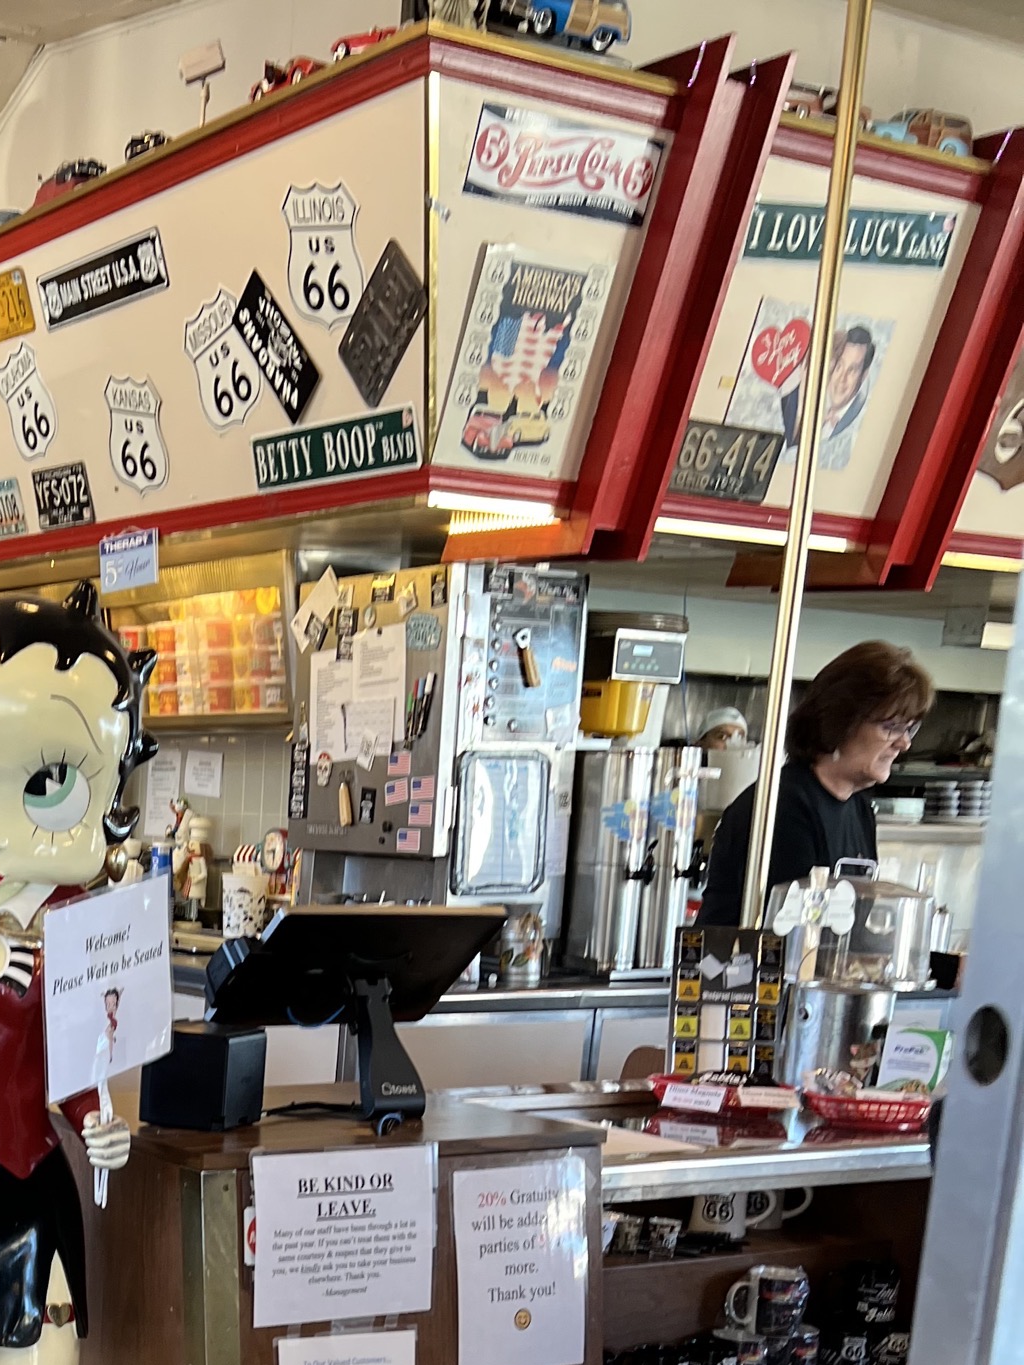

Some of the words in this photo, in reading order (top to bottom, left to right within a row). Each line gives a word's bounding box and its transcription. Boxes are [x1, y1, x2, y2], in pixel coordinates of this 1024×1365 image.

[293, 197, 345, 223] ILLINOIS
[767, 212, 826, 252] LOV
[843, 217, 914, 258] LUCY
[905, 231, 949, 260] LANE
[60, 277, 82, 308] MAIN
[80, 264, 112, 301] STREET
[112, 255, 139, 288] U.S.A.
[303, 261, 350, 310] 66
[492, 270, 504, 283] 66
[511, 266, 583, 294] AMERICA'S
[512, 284, 577, 313] HIGHWAY
[587, 285, 600, 298] 66
[481, 311, 493, 324] 66
[576, 326, 588, 339] 66
[469, 350, 482, 364] 66
[564, 365, 576, 378] 66
[214, 357, 251, 417] 66
[112, 387, 150, 412] KANSAS
[459, 391, 471, 404] 66
[552, 406, 564, 418] 66
[22, 400, 50, 451] 66
[121, 437, 157, 481] 66
[256, 435, 312, 484] BETTY
[323, 422, 376, 473] BOOP
[381, 431, 414, 463] BLVD
[513, 450, 539, 463] ROUTE
[679, 427, 776, 482] 66-414
[104, 531, 148, 554] THERAPY
[85, 924, 131, 954] Welcome!
[53, 973, 83, 995] Please
[86, 963, 108, 981] Wait
[110, 960, 119, 974] to
[121, 955, 132, 970] be
[134, 941, 163, 967] Seated
[298, 1177, 319, 1194] BE
[325, 1174, 365, 1192] KIND
[369, 1172, 393, 1190] OR
[478, 1191, 507, 1209] 20%
[706, 1201, 730, 1219] 66
[274, 1230, 293, 1239] Many
[295, 1228, 303, 1237] of
[317, 1226, 333, 1235] staff
[333, 1225, 349, 1233] have
[351, 1224, 366, 1232] been
[367, 1221, 393, 1231] through
[399, 1220, 408, 1228] lot
[410, 1220, 416, 1228] in
[471, 1216, 495, 1232] will
[499, 1215, 515, 1228] be
[284, 1242, 298, 1251] past
[318, 1239, 325, 1247] If
[326, 1239, 338, 1247] you
[392, 1233, 406, 1241] with
[479, 1241, 520, 1259] parties
[523, 1233, 537, 1250] of
[297, 1251, 325, 1261] courtesy
[335, 1249, 358, 1258] respect
[360, 1247, 372, 1255] that
[374, 1246, 387, 1255] they
[389, 1245, 403, 1255] give
[300, 1264, 321, 1274] kindly
[322, 1263, 333, 1271] ask
[335, 1262, 348, 1271] you
[357, 1260, 371, 1268] take
[373, 1258, 387, 1267] your
[504, 1262, 539, 1276] more.
[345, 1271, 365, 1281] Thank
[487, 1285, 526, 1302] Thank
[529, 1282, 557, 1302] you!
